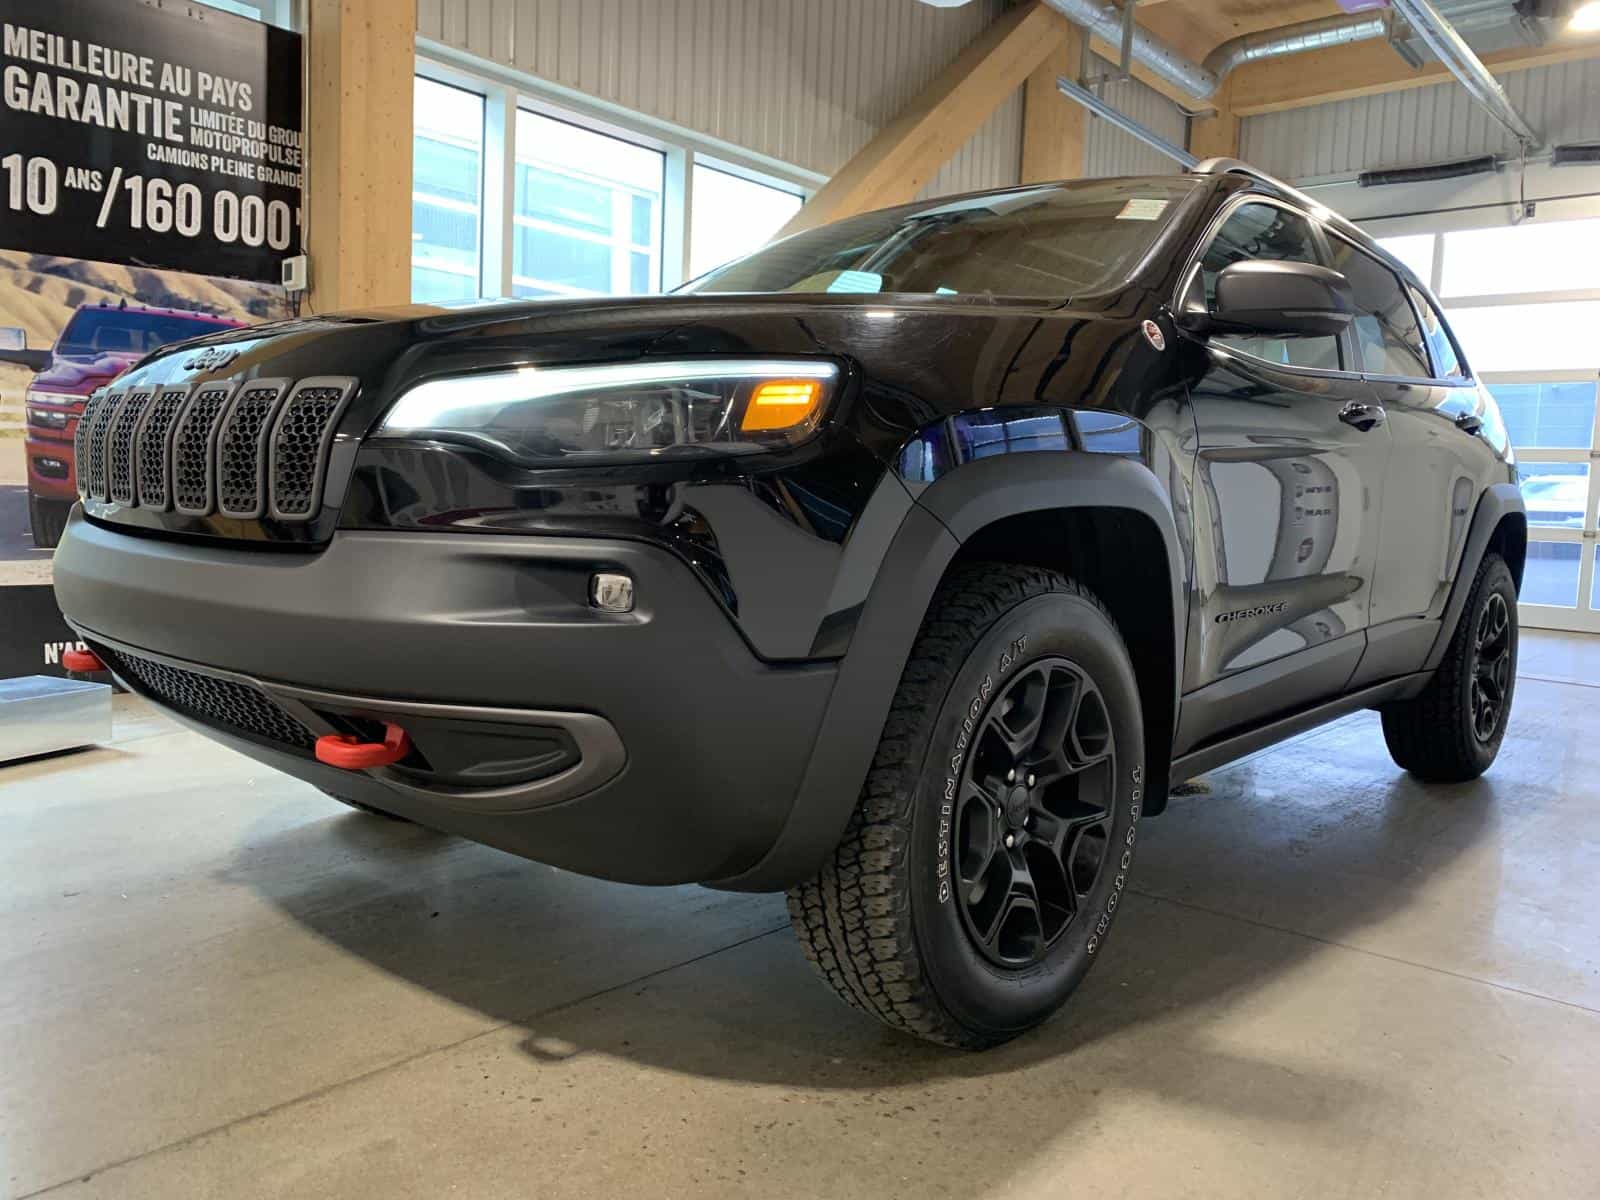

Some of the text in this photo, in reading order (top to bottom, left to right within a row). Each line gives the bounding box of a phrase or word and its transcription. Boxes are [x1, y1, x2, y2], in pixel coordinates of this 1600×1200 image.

[4, 23, 252, 111] MEILLEURE AU PAYS
[4, 65, 183, 143] GARANTIE
[147, 143, 208, 171] CAMIONS
[211, 155, 255, 180] PLEINE
[190, 106, 245, 137] LIMITÉE
[248, 119, 266, 140] DU
[2, 153, 57, 215] 10
[65, 167, 103, 192] ANS
[214, 189, 290, 250] 000
[1214, 600, 1288, 624] CHEROKEE
[938, 674, 994, 904] DESTINATION
